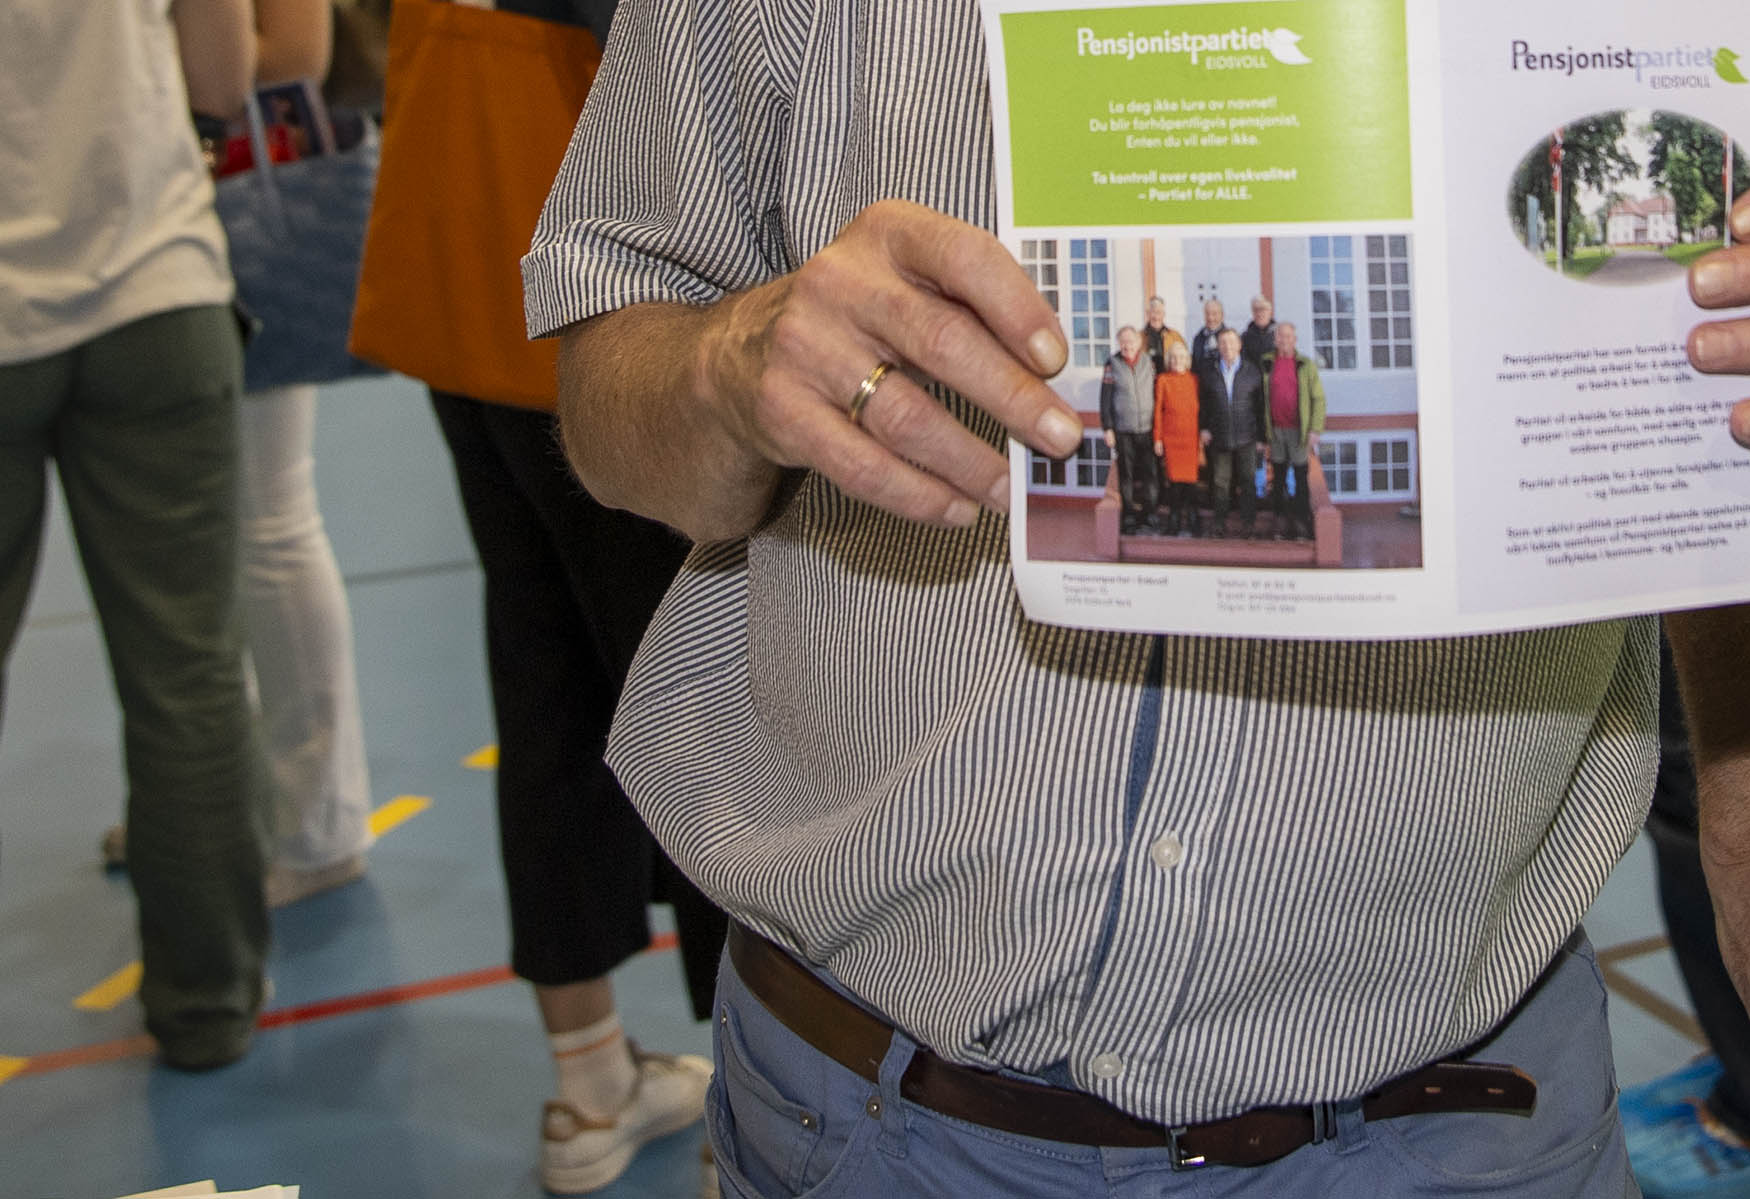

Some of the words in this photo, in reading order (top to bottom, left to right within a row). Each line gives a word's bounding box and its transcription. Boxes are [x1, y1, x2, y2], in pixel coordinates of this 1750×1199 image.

[1077, 28, 1272, 64] Pensjonistpartiet
[1206, 55, 1268, 70] EIDSVOLL
[1512, 40, 1713, 83] Pensjonistpartiet
[1651, 75, 1710, 90] EIDSVOLL
[1126, 135, 1162, 148] Enten
[1149, 187, 1192, 201] Partiet
[1194, 186, 1214, 200] for
[1216, 185, 1252, 200] ALLE.
